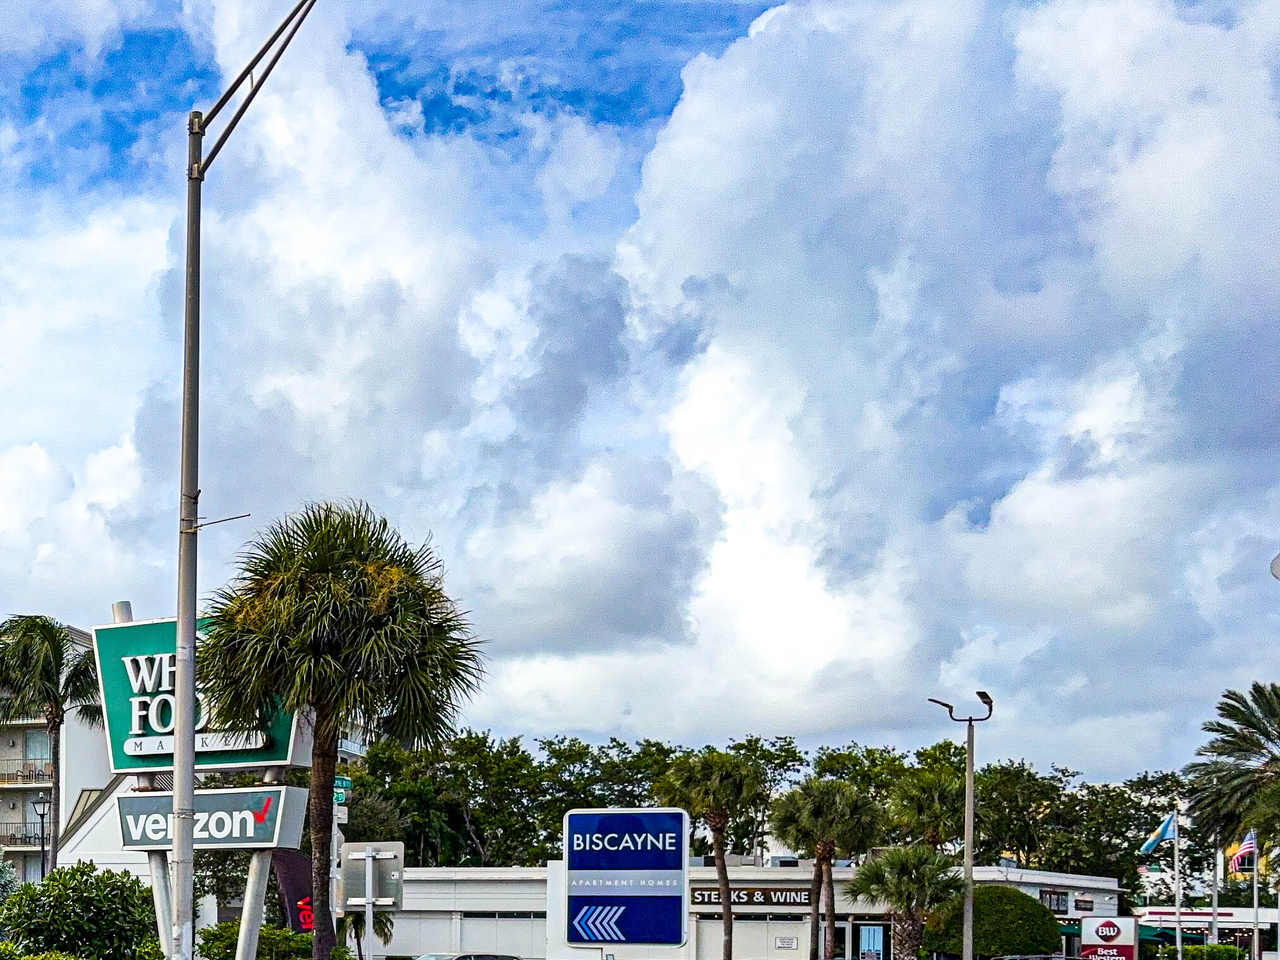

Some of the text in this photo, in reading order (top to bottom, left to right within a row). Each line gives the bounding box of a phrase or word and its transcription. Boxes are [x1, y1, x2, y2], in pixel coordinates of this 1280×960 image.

[573, 833, 676, 850] BISCAYNE
[694, 891, 809, 903] STEKS & WINE
[1098, 926, 1118, 936] BW
[1097, 947, 1118, 956] Best
